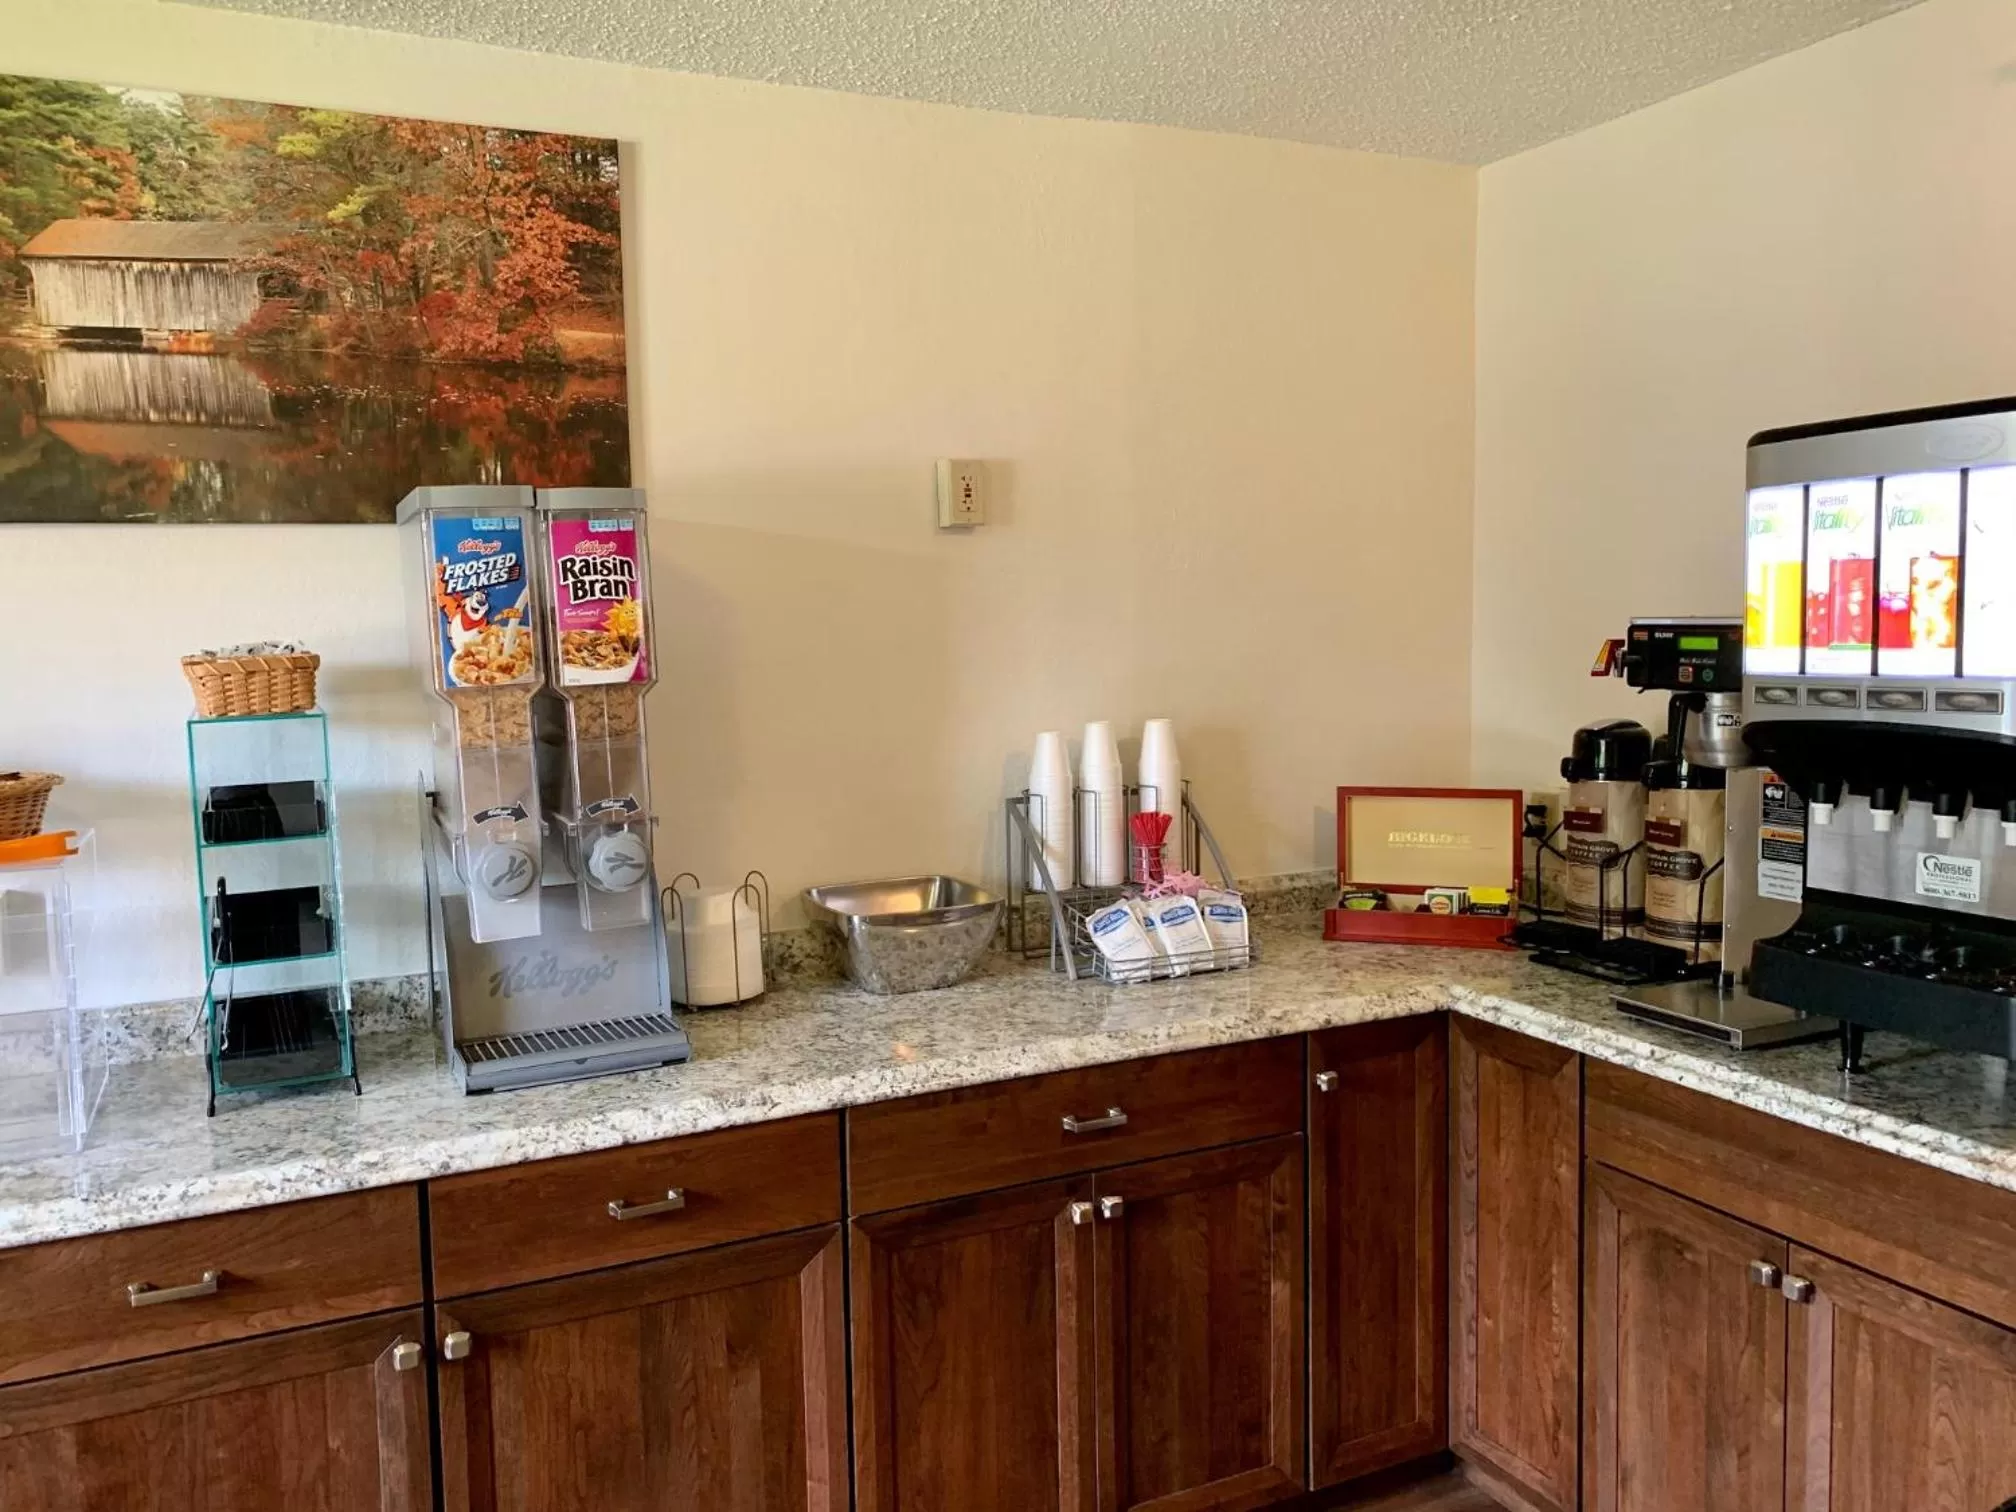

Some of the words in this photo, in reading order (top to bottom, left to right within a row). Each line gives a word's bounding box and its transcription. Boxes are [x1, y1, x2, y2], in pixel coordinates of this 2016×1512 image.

[443, 553, 517, 580] FROSTED
[558, 555, 636, 584] Raisin
[447, 567, 509, 594] FLAKES
[570, 578, 632, 603] Bran
[488, 949, 619, 998] Kellogg's
